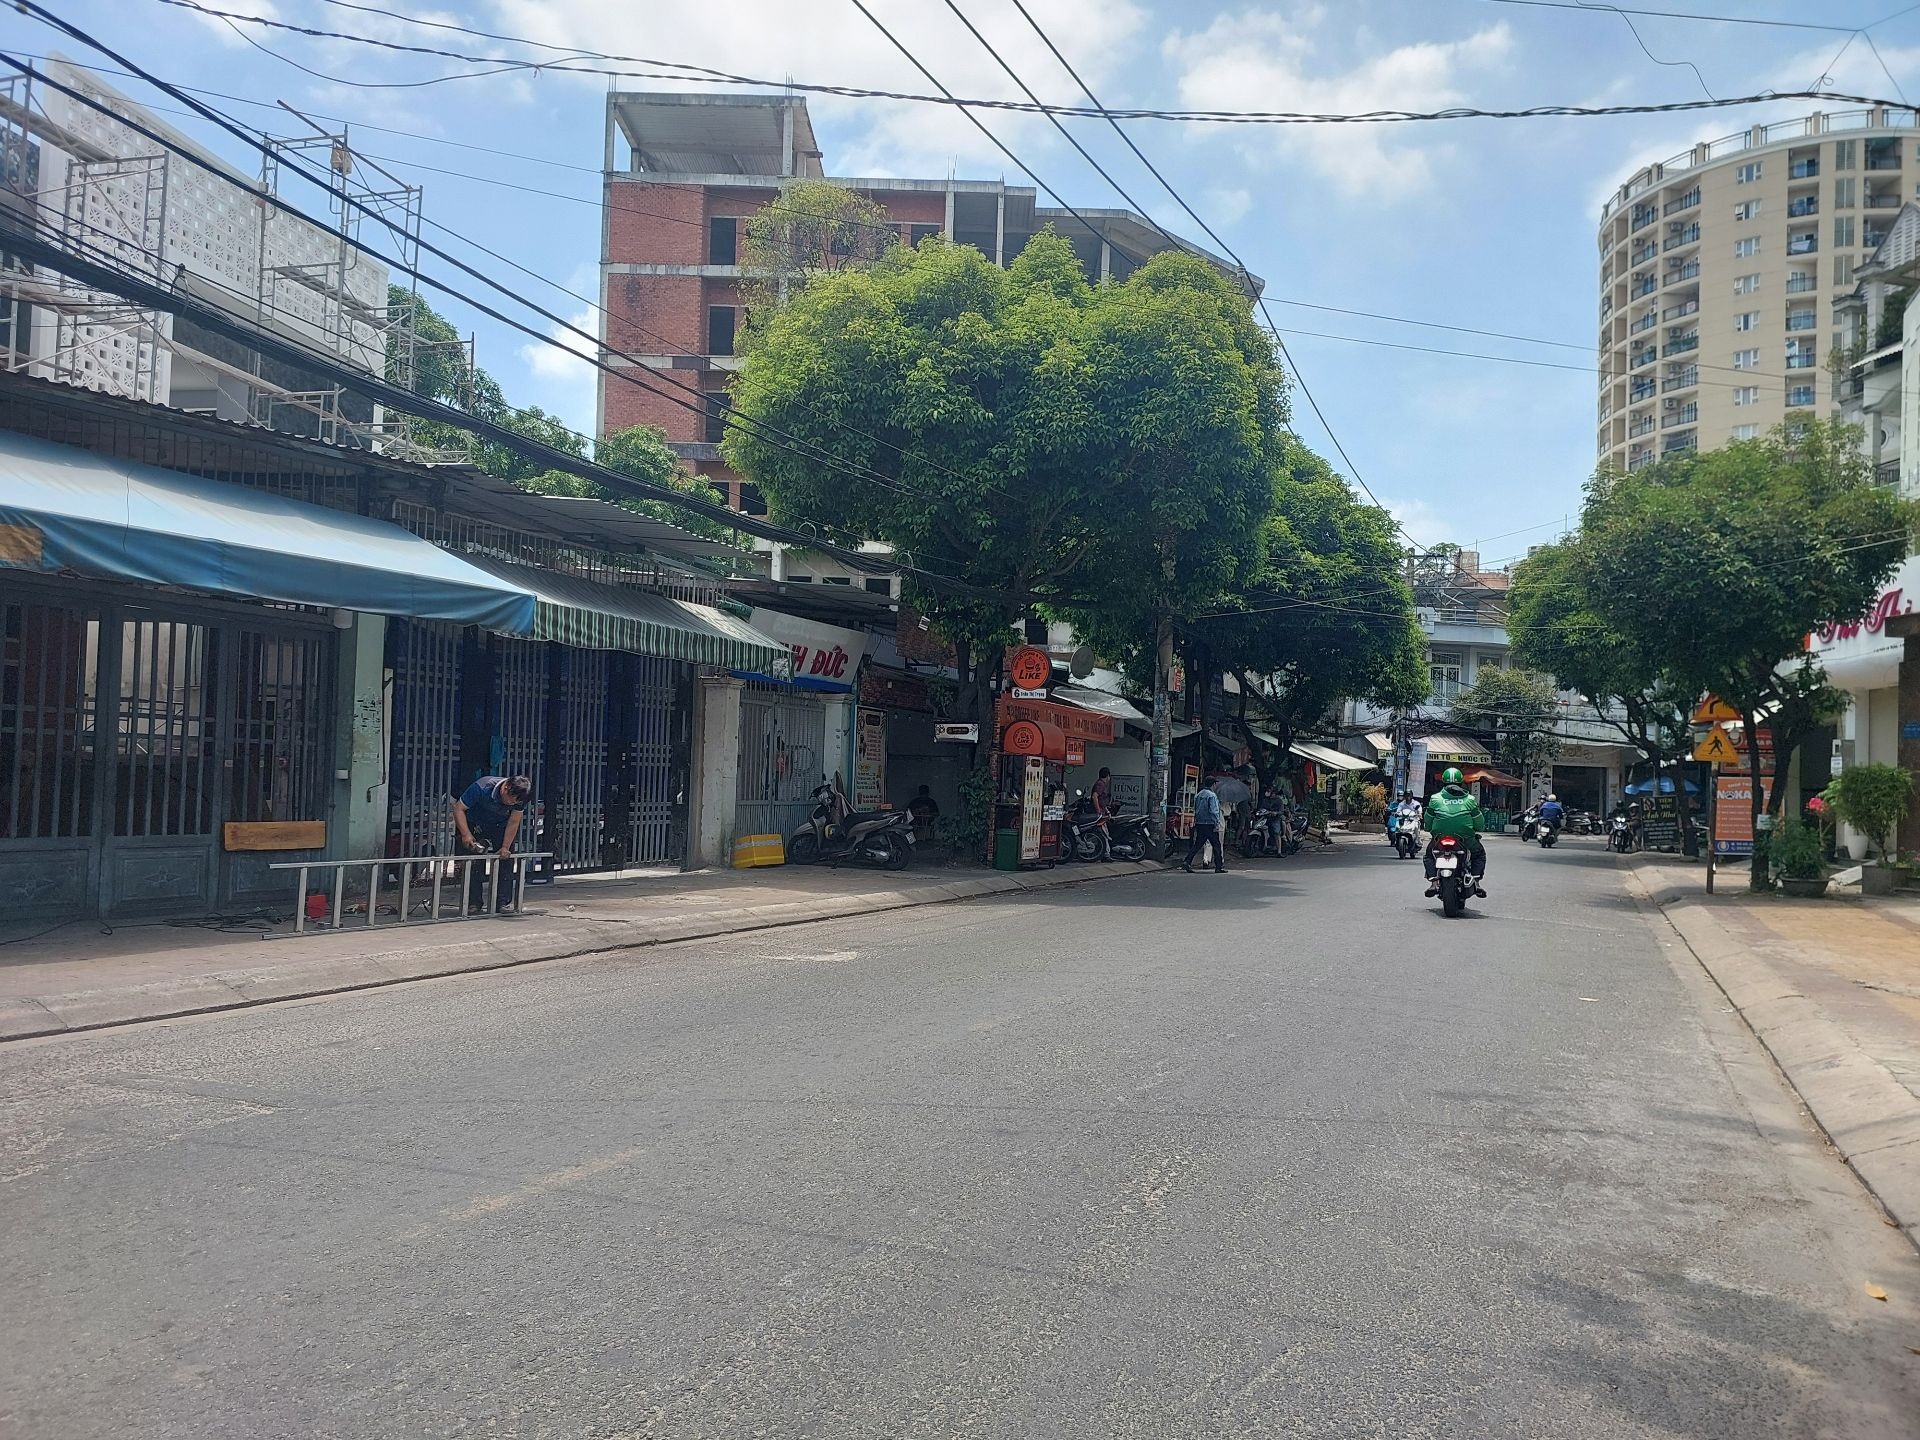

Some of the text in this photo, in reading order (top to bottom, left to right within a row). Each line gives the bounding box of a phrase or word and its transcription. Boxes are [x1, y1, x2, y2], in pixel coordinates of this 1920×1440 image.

[809, 645, 849, 679] ĐỨC
[1019, 669, 1042, 680] LIKE
[1014, 689, 1020, 698] 6
